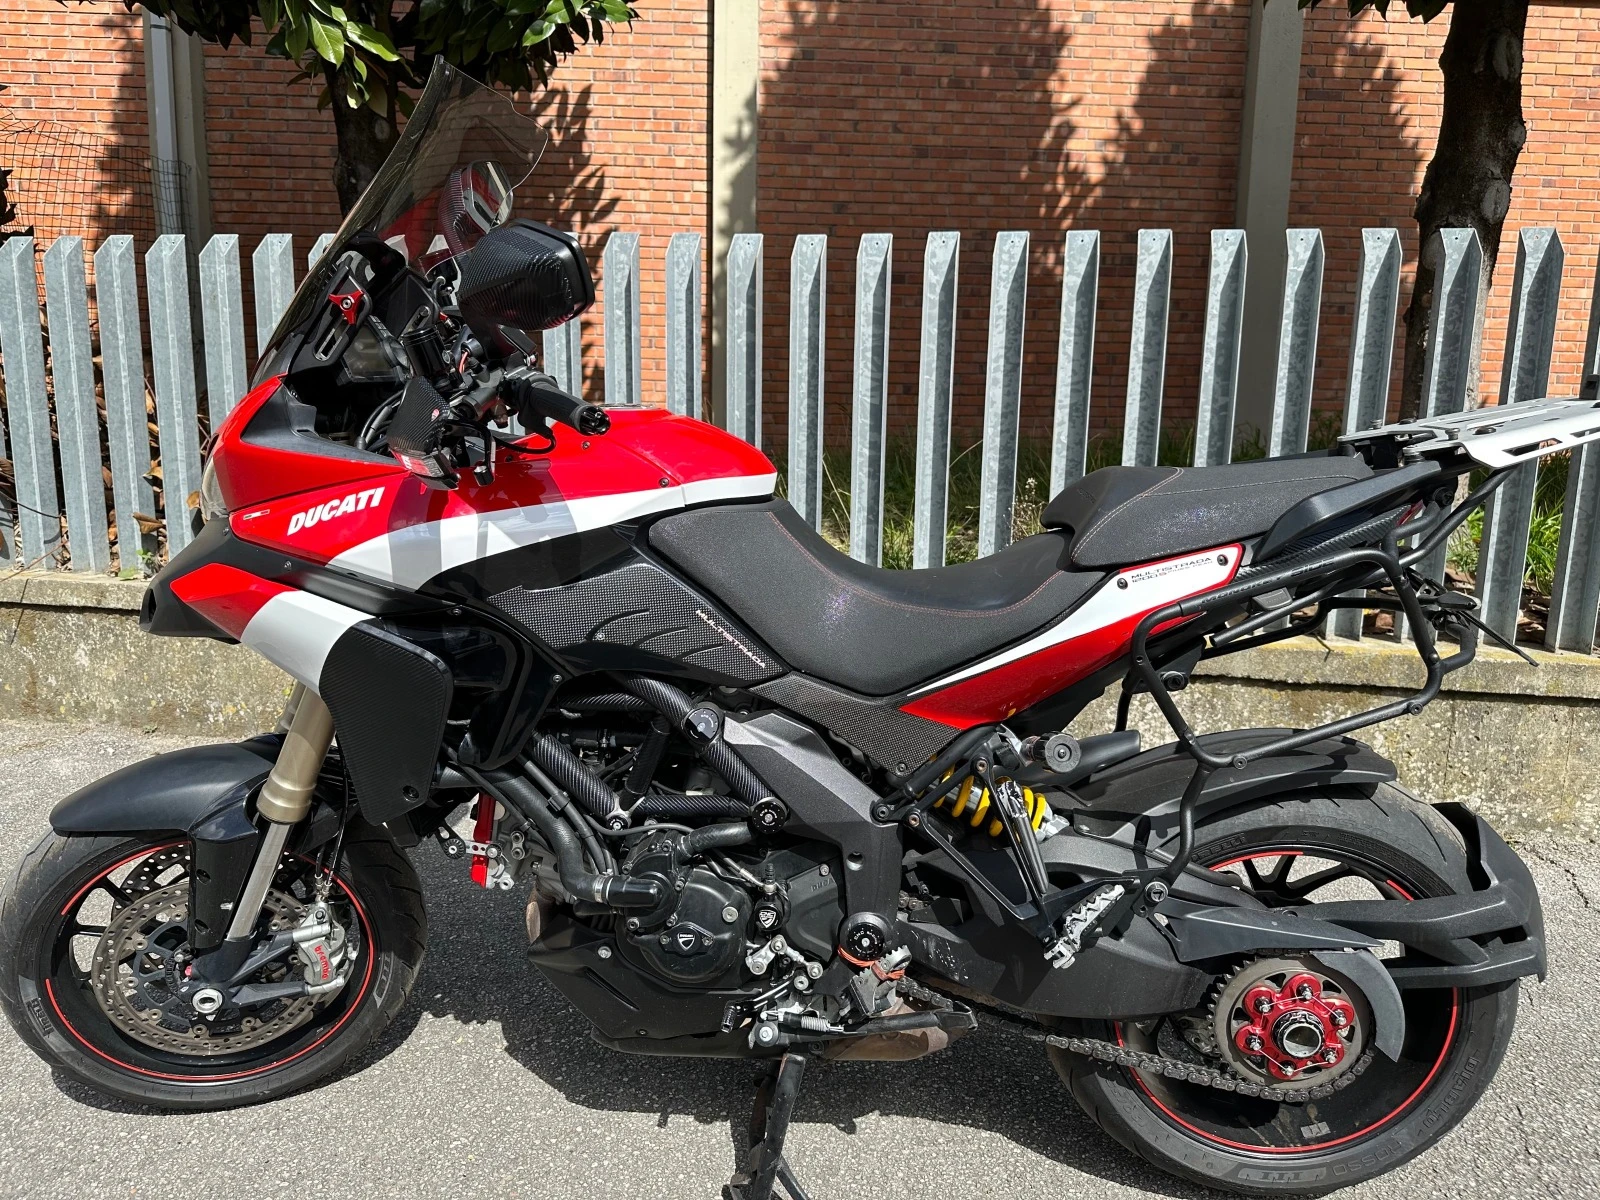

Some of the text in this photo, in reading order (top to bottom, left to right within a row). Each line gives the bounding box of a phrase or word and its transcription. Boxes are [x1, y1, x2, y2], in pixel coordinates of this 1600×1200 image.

[286, 486, 385, 536] DUCATI
[1131, 557, 1212, 579] MULTISTRADA
[695, 609, 766, 669] MULTISTRADA
[810, 877, 837, 893] DUCA
[314, 944, 330, 980] brembo
[1423, 1055, 1480, 1130] DIABLO
[1331, 1140, 1403, 1177] ROSSO
